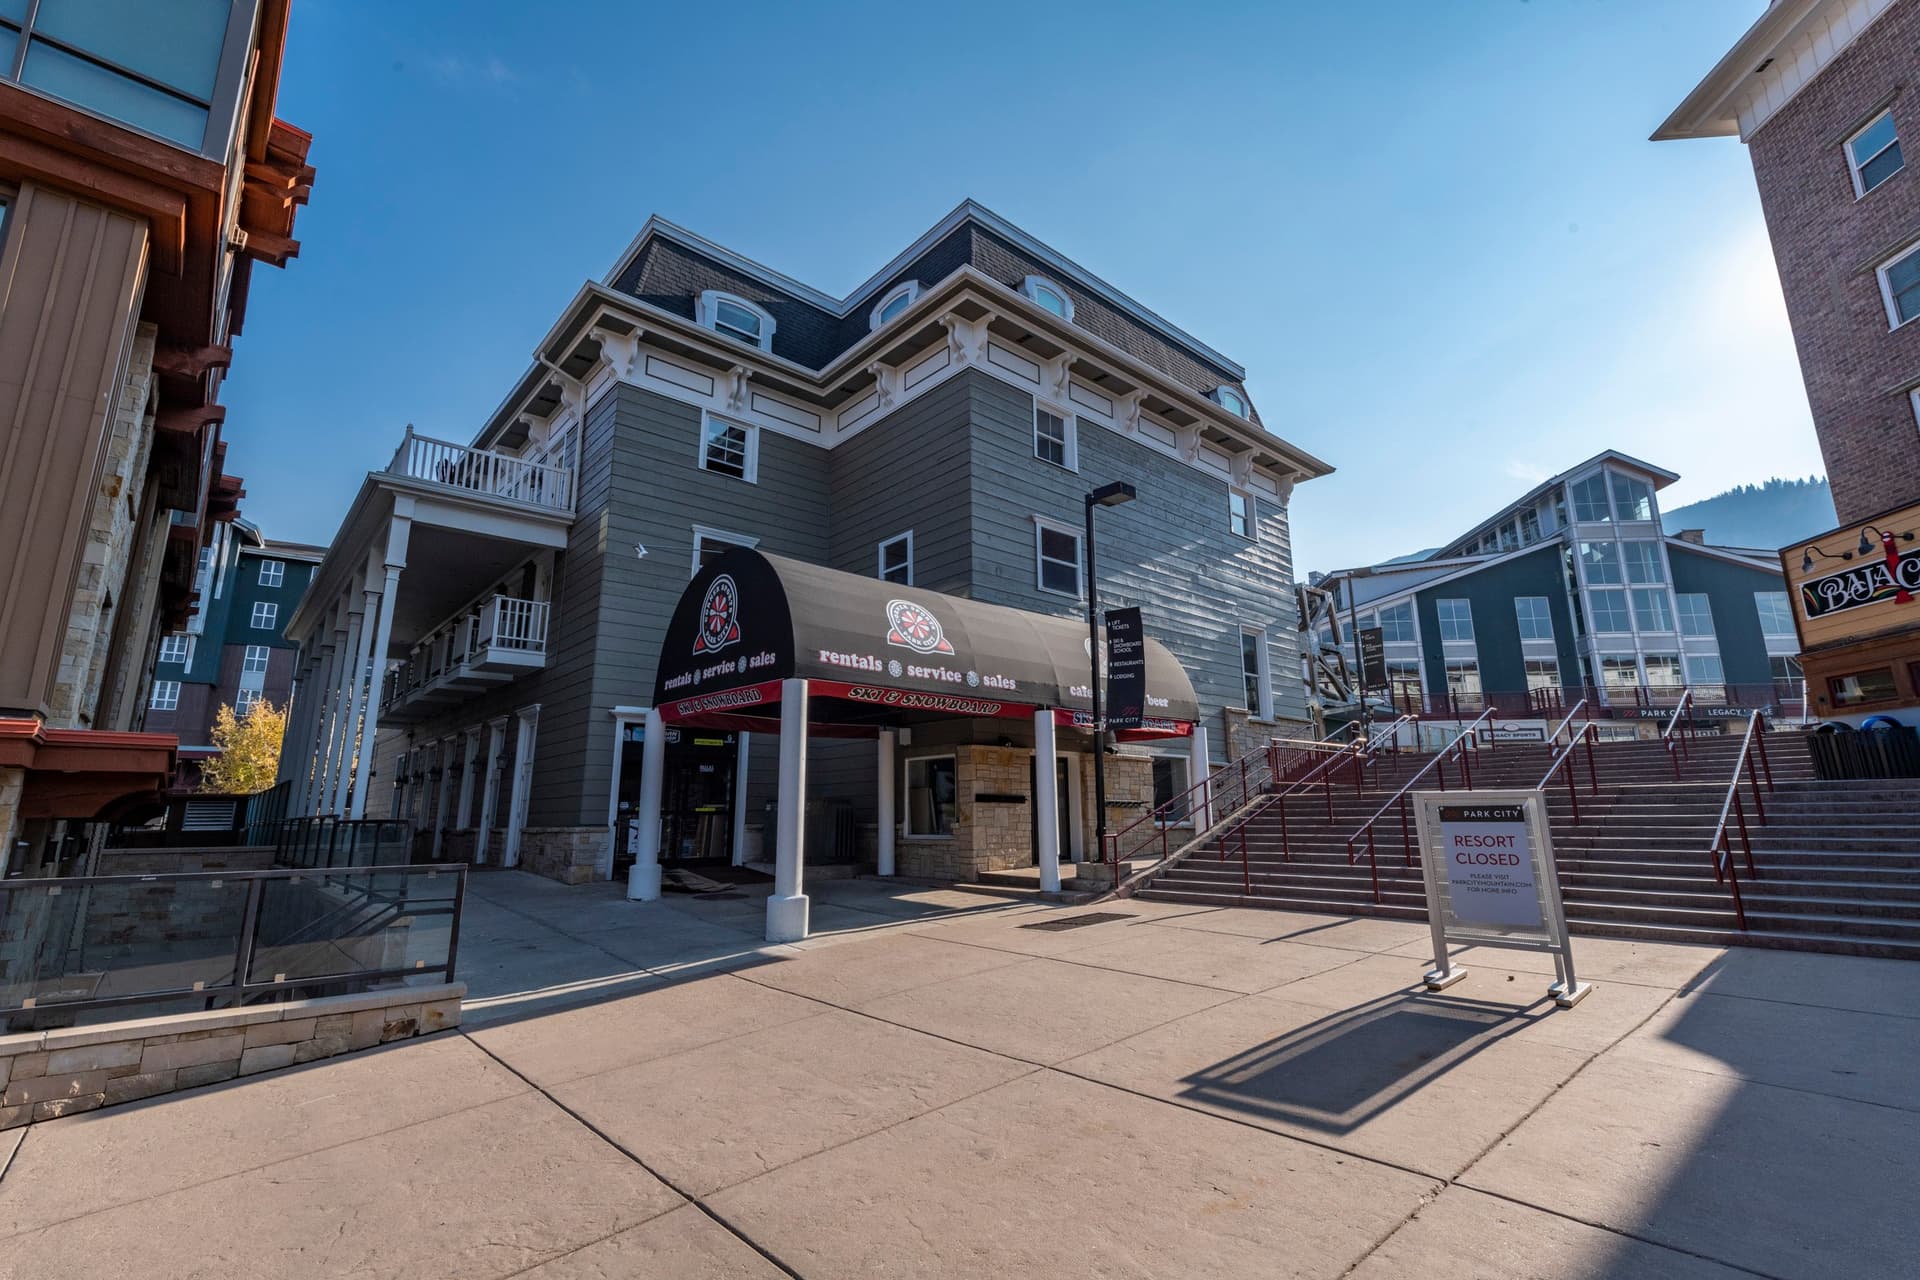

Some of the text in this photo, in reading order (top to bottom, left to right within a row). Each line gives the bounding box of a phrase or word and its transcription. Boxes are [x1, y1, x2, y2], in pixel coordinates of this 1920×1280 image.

[1817, 564, 1901, 612] BAJA
[903, 631, 936, 647] PARK CITY
[1113, 641, 1142, 649] SNOWBOARD
[664, 651, 776, 690] rentals service sales
[819, 650, 1016, 690] rentals service sales
[677, 688, 763, 715] SKI & SNOWBOARD
[848, 687, 1001, 715] SKI & SNOWBOARD
[1146, 694, 1169, 707] beer
[1641, 709, 1667, 717] PARK
[1463, 810, 1519, 818] PARK CITY
[1454, 835, 1515, 848] RESORT
[1456, 853, 1520, 866] CLOSED
[1452, 880, 1532, 888] PARKCITYMOUNTAIN.COM
